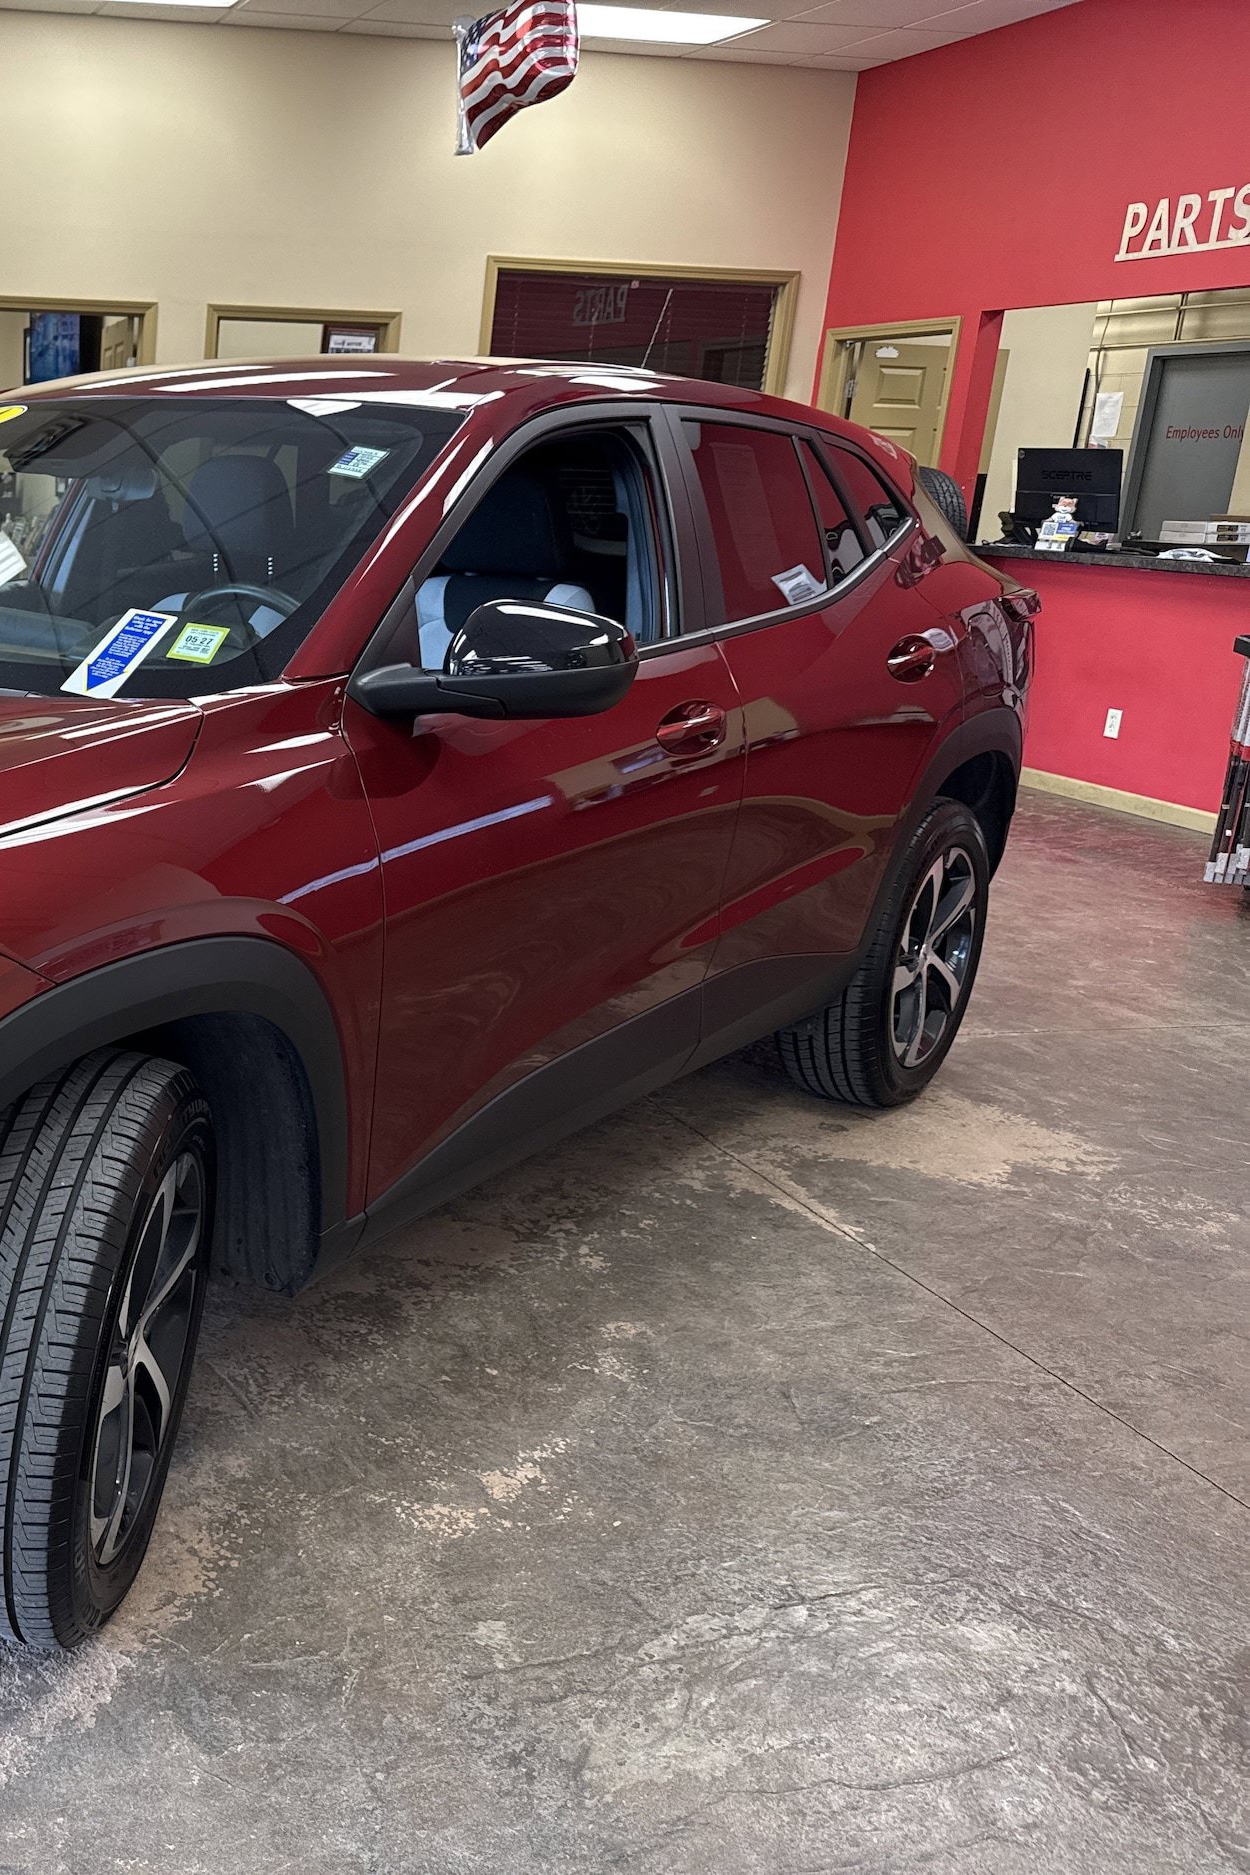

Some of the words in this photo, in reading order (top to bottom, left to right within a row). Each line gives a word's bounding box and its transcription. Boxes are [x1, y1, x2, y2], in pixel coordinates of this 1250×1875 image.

[1114, 183, 1250, 262] PARTS
[1165, 425, 1220, 443] Employees
[1041, 469, 1093, 481] SCEPTRE
[185, 634, 198, 643] 05
[199, 637, 215, 646] 27
